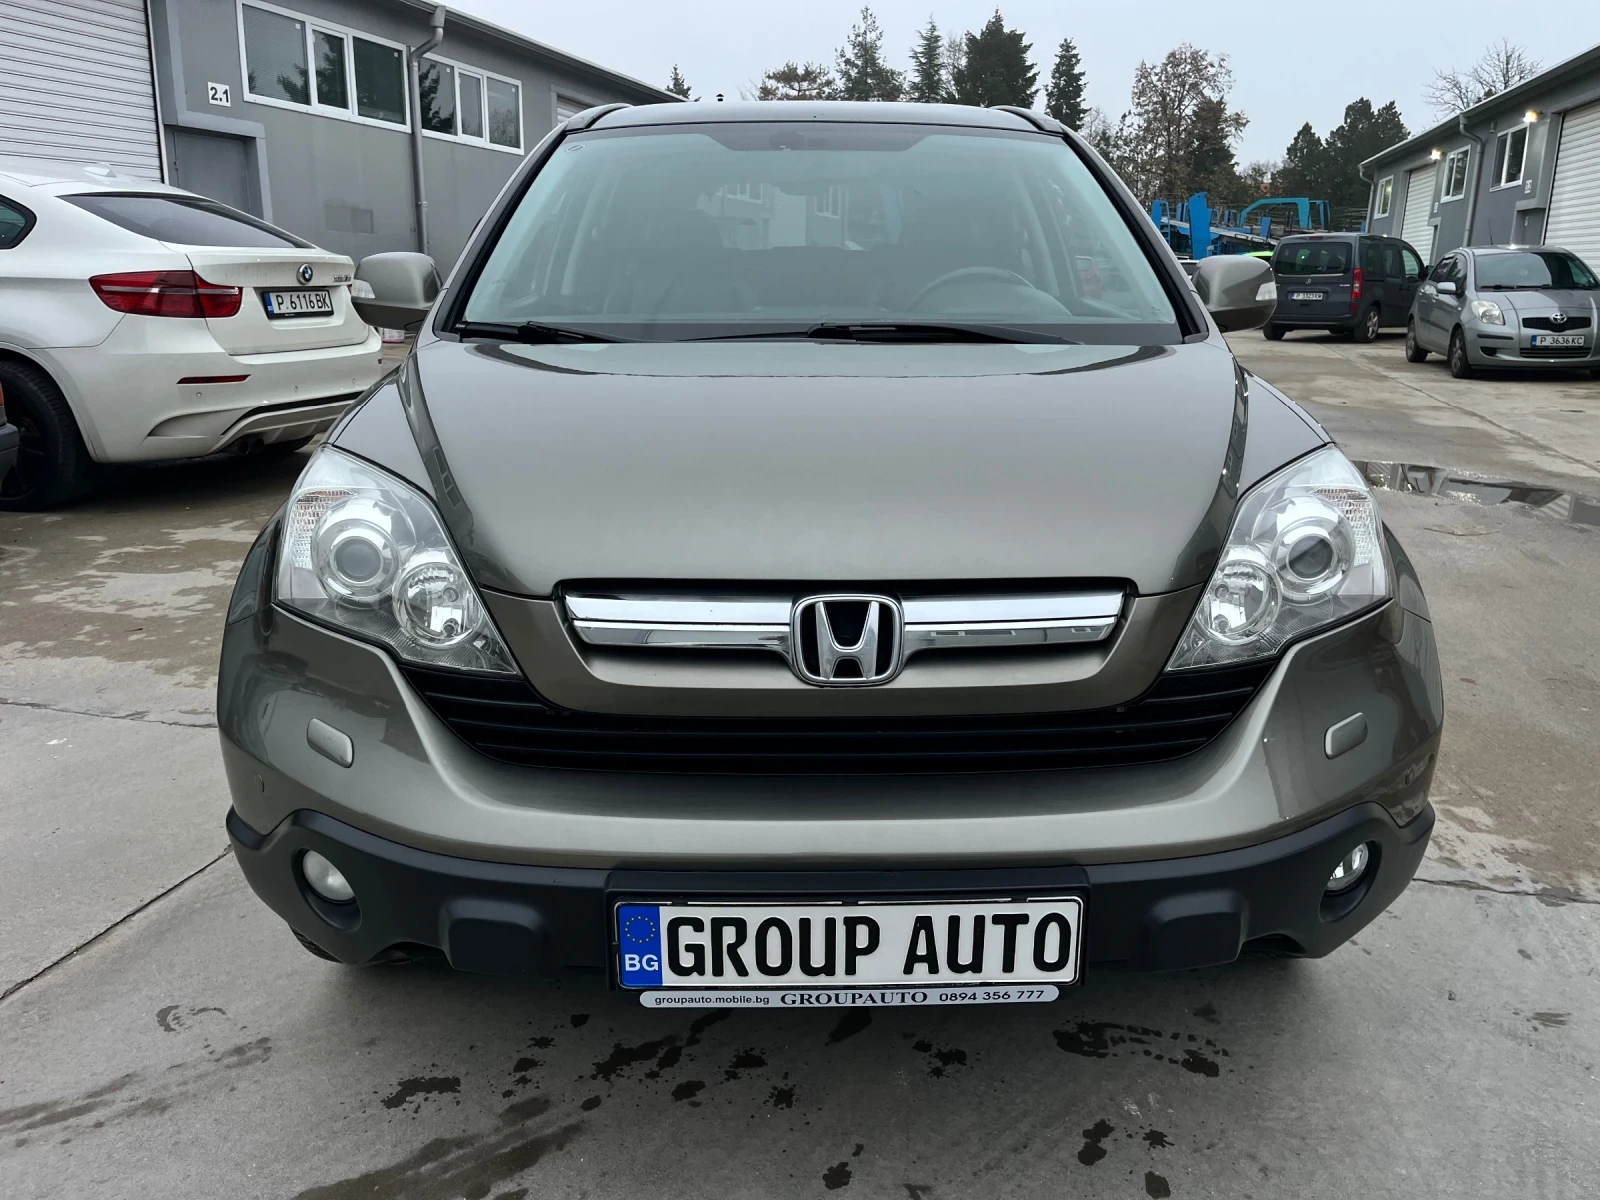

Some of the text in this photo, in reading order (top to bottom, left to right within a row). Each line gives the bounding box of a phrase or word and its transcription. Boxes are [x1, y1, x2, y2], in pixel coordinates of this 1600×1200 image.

[210, 86, 229, 103] 2.1
[275, 294, 284, 311] P
[1540, 336, 1547, 345] P
[667, 912, 1072, 977] GROUP AUTO
[624, 954, 659, 972] BG
[654, 990, 1045, 1006] groupauto.mobile.bg GROUPAUTO 0894 356 777
